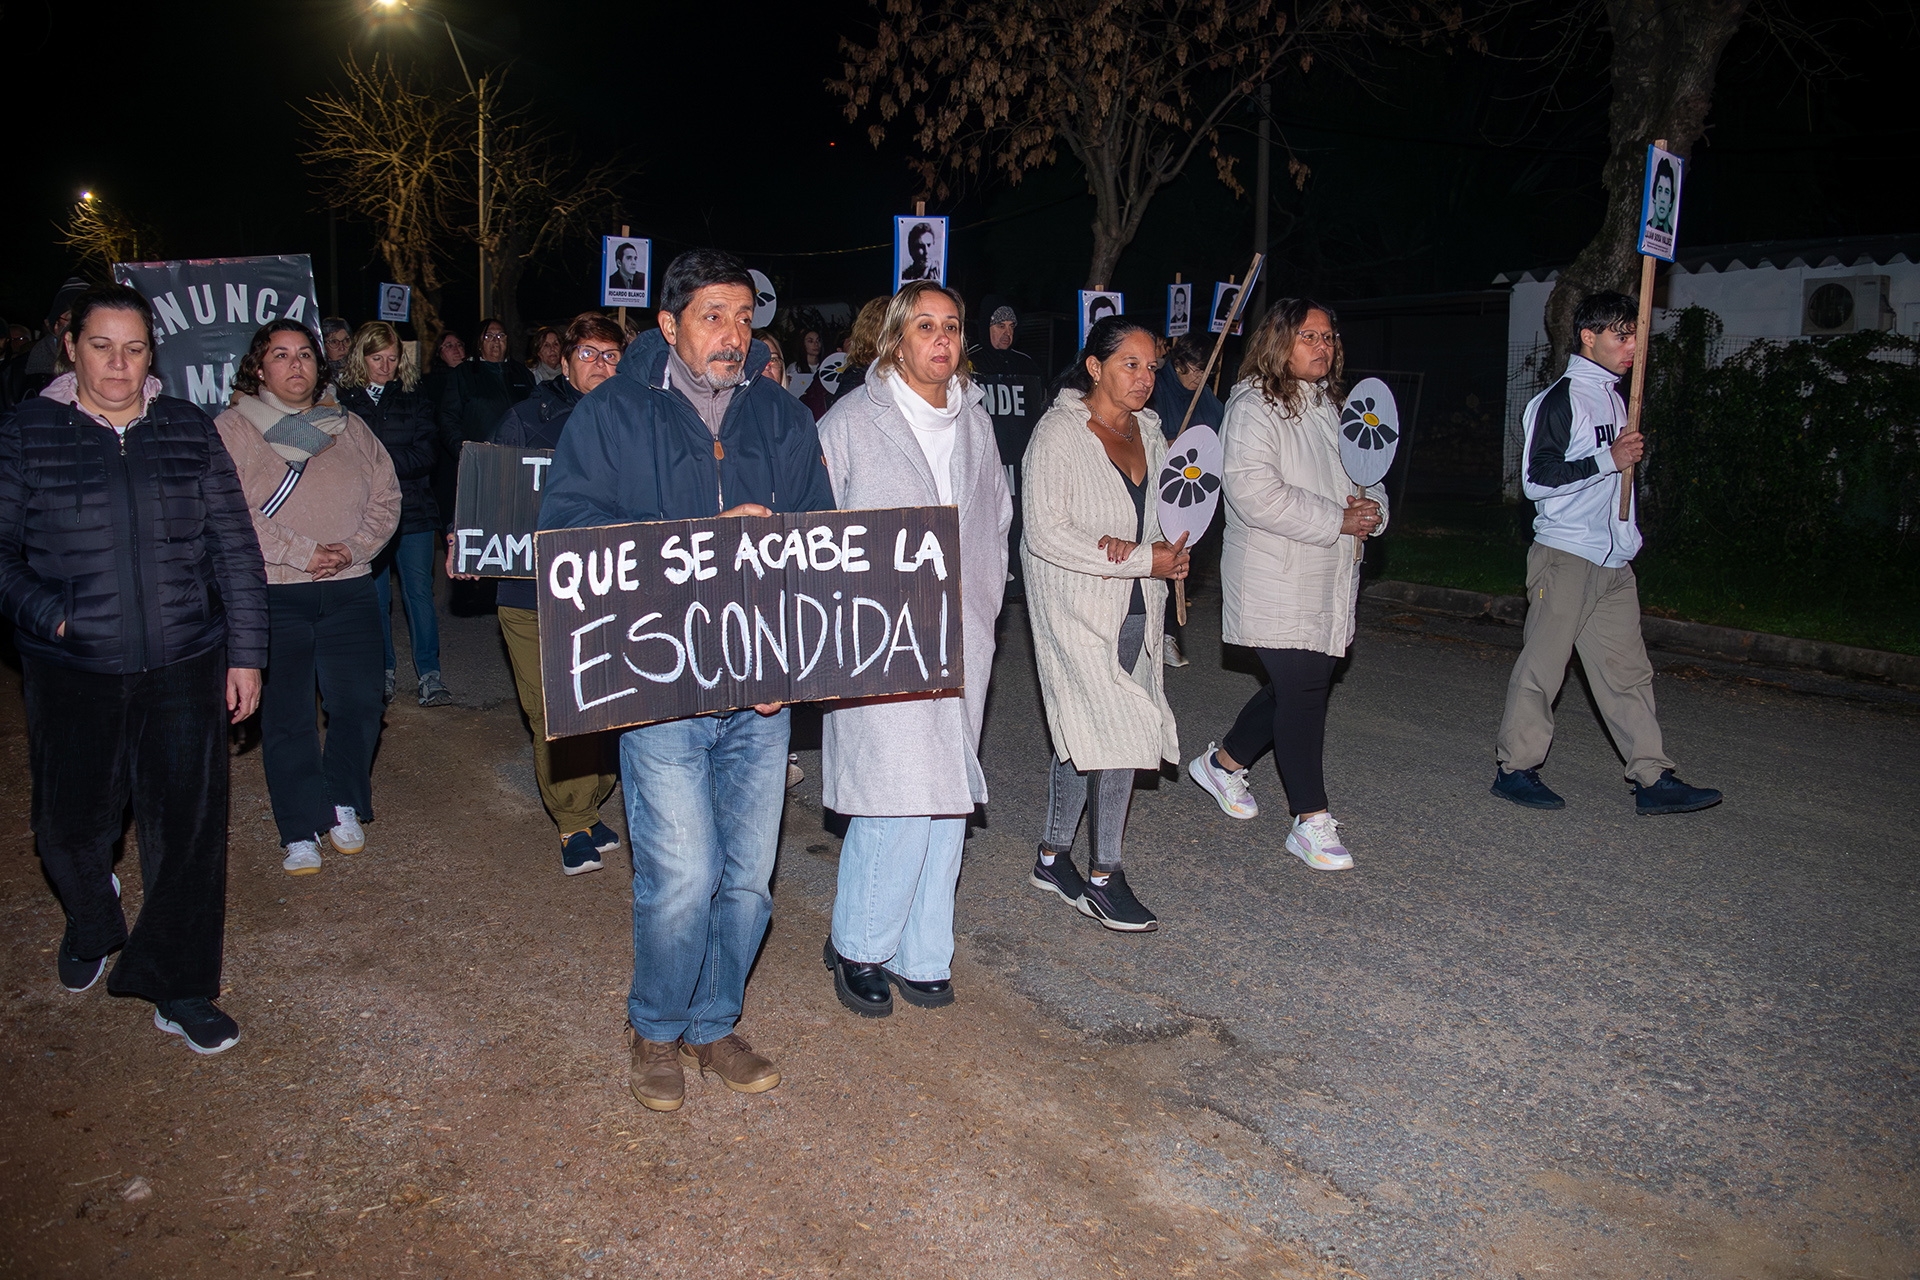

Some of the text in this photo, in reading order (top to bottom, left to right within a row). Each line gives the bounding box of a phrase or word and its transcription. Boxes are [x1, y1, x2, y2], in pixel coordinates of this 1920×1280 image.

[152, 283, 307, 345] NUNCA
[185, 353, 236, 406] MÁ
[978, 384, 1025, 416] NDE
[1594, 423, 1615, 448] PU
[457, 529, 533, 573] FAM
[550, 525, 948, 611] QUE SE ACABE LA
